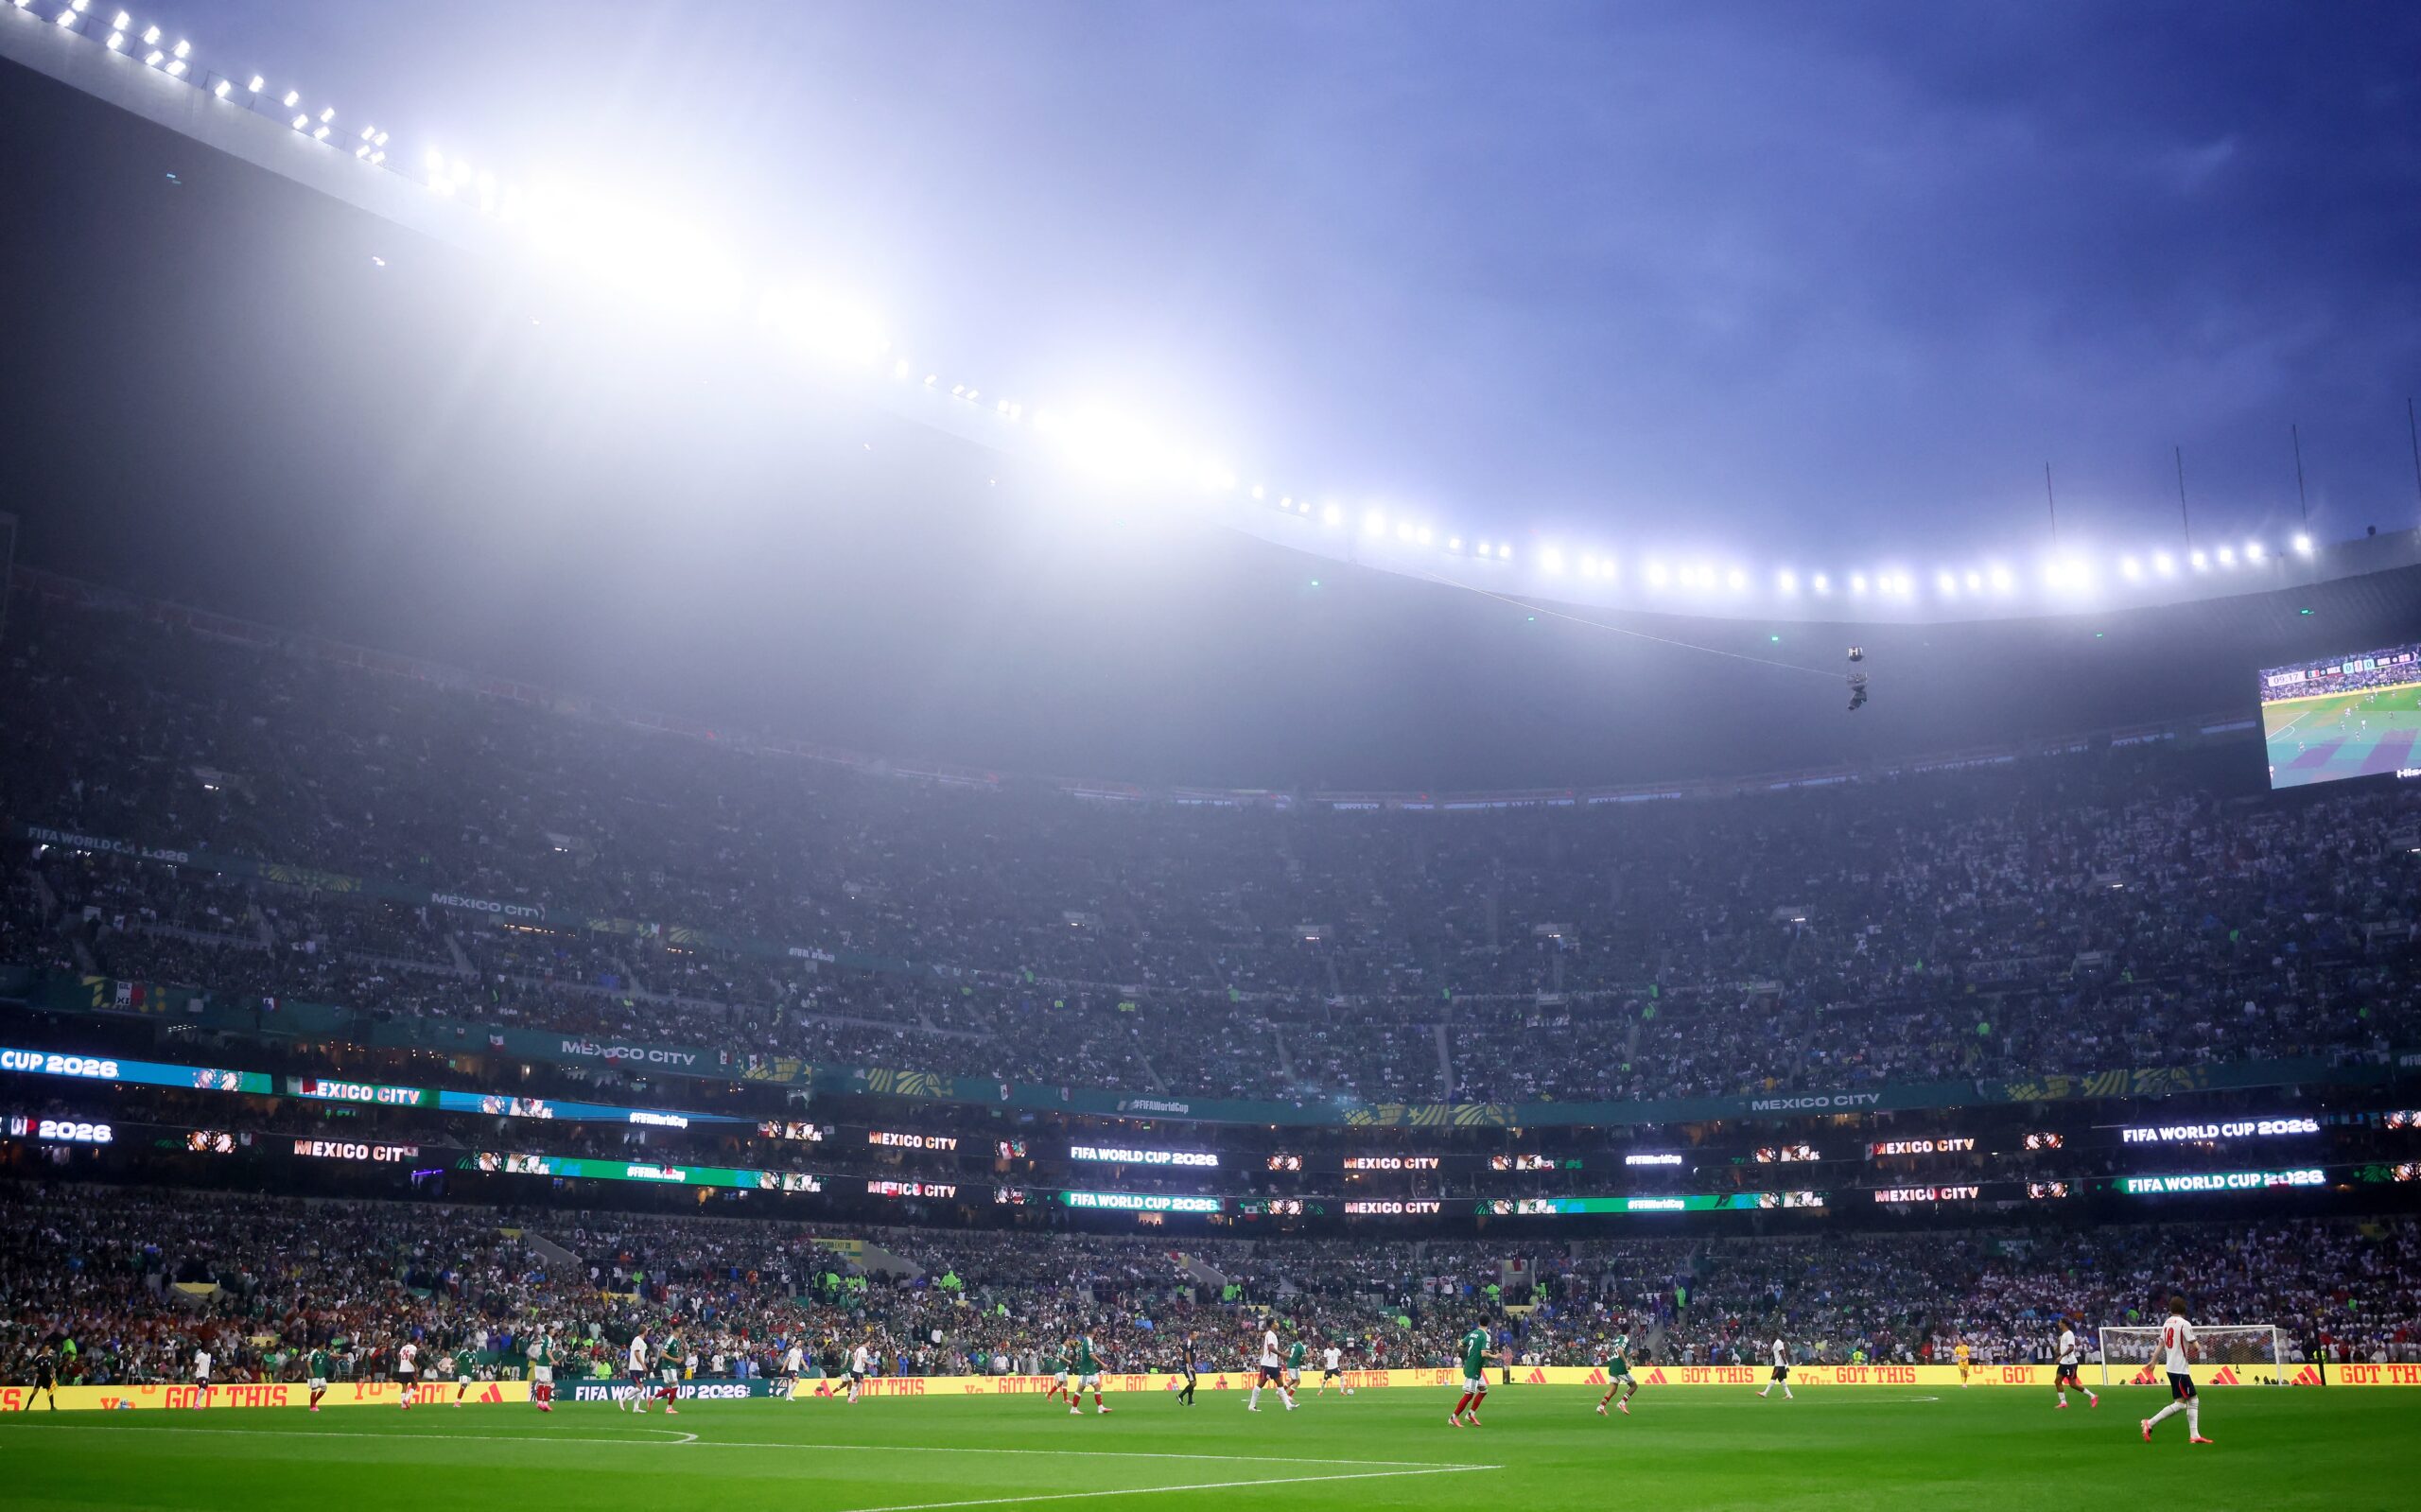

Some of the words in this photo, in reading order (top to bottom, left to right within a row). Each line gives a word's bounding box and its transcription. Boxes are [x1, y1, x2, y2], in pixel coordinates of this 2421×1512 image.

[432, 893, 501, 912] MEXICO
[1, 1051, 43, 1072] CUP
[46, 1055, 119, 1078] 2026
[648, 1050, 696, 1065] CITY
[299, 1082, 373, 1101] EXICO
[377, 1088, 421, 1104] CITY
[1752, 1097, 1829, 1111] MEXICO
[1833, 1093, 1881, 1106] CITY
[1134, 1100, 1189, 1114] #FIFAWorldCup
[39, 1120, 112, 1143] 2026
[2123, 1128, 2158, 1142] FIFA
[2159, 1125, 2220, 1140] WORLD
[2221, 1122, 2256, 1137] CUP
[2258, 1119, 2318, 1135] 2026
[869, 1131, 923, 1147] MEXICO
[925, 1137, 957, 1150] CITY
[1937, 1138, 1976, 1153] CITY
[294, 1140, 369, 1160] MEXICO
[1071, 1147, 1099, 1159] FIFA
[1098, 1148, 1144, 1162] WORLD
[1145, 1151, 1171, 1164] CUP
[1172, 1153, 1218, 1166] 2026
[1344, 1157, 1401, 1169] MEXICO
[1404, 1157, 1439, 1169] CITY
[2128, 1178, 2164, 1193] FIFA
[2165, 1176, 2225, 1191] WORLD
[2230, 1173, 2261, 1188] CUP
[2264, 1170, 2325, 1185] 2026
[924, 1184, 956, 1198] CITY
[1875, 1187, 1937, 1203] MEXICO
[1940, 1186, 1979, 1201] CITY
[1070, 1193, 1097, 1206] FIFA
[1097, 1195, 1144, 1208] WORLD
[1145, 1197, 1171, 1209] CUP
[1172, 1198, 1219, 1211] 2026
[1345, 1202, 1402, 1214] MEXICO
[1405, 1202, 1440, 1214] CITY
[2164, 1327, 2174, 1349] 18
[1343, 1371, 1363, 1388] GOT
[1364, 1371, 1389, 1387] THIS
[1681, 1367, 1711, 1383] GOT
[1716, 1367, 1754, 1383] THIS
[1836, 1366, 1869, 1383] GOT
[1873, 1366, 1916, 1383] THIS
[2340, 1365, 2381, 1383] GOT
[575, 1386, 609, 1401] FIFA
[676, 1385, 696, 1399] UP
[697, 1384, 747, 1399] 2026
[857, 1379, 883, 1396] OT
[887, 1378, 924, 1395] THIS
[998, 1377, 1026, 1393] GOT
[165, 1386, 218, 1408] GOT
[226, 1385, 288, 1408] THIS
